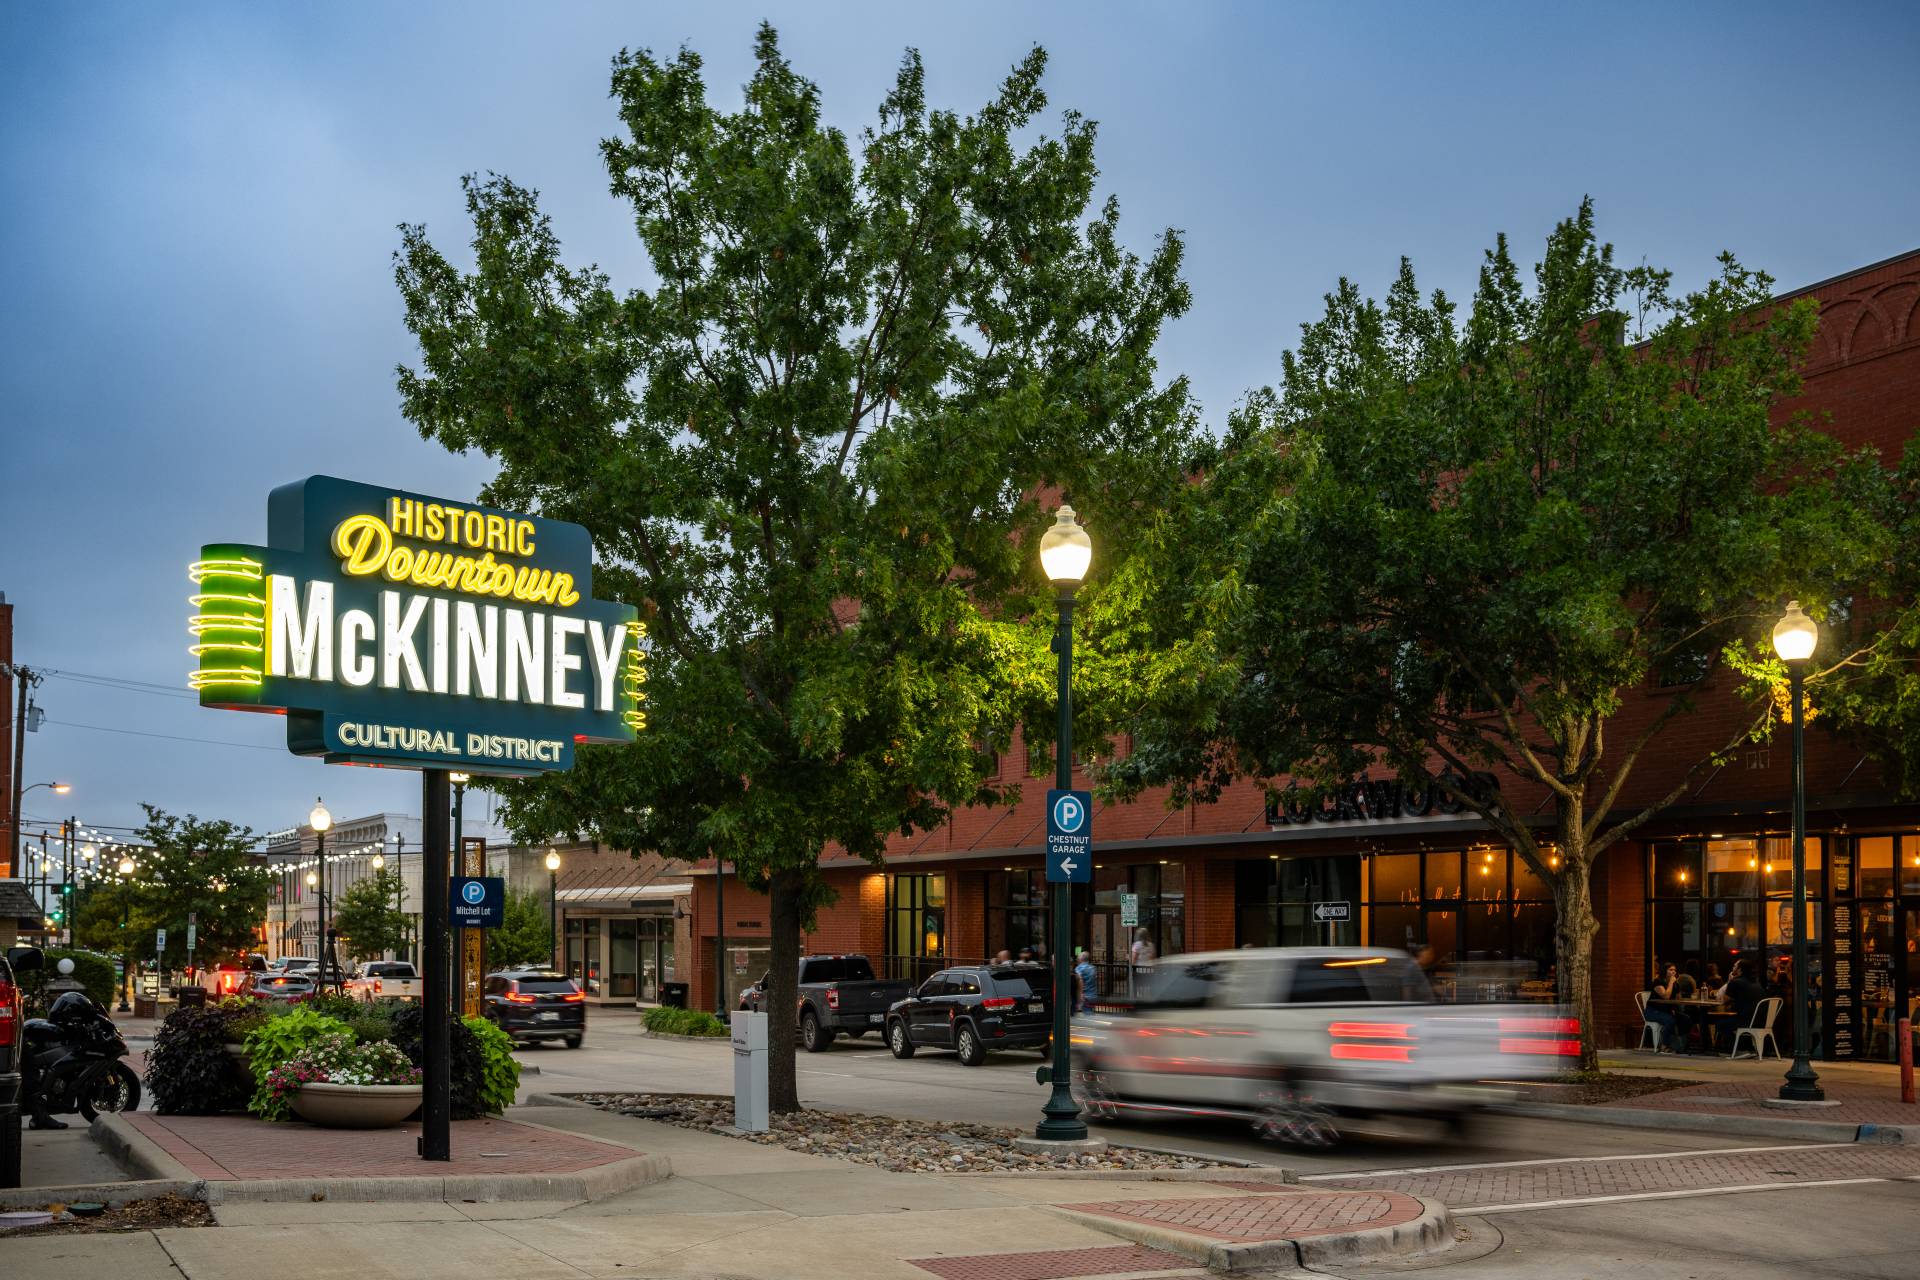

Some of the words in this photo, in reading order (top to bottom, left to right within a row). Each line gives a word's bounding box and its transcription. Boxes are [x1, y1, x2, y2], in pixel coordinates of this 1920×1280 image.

[388, 496, 536, 557] HISTORIC
[333, 514, 580, 607] Downtown
[267, 573, 628, 712] McKINNEY
[338, 721, 461, 755] CULTURAL
[467, 732, 564, 763] DISTRICT
[1048, 835, 1090, 845] CHESTNUT
[1052, 845, 1085, 854] GARAGE
[456, 906, 480, 915] Mitchell
[481, 907, 491, 916] Lot
[1323, 907, 1333, 916] ONE
[1334, 907, 1346, 916] WAY
